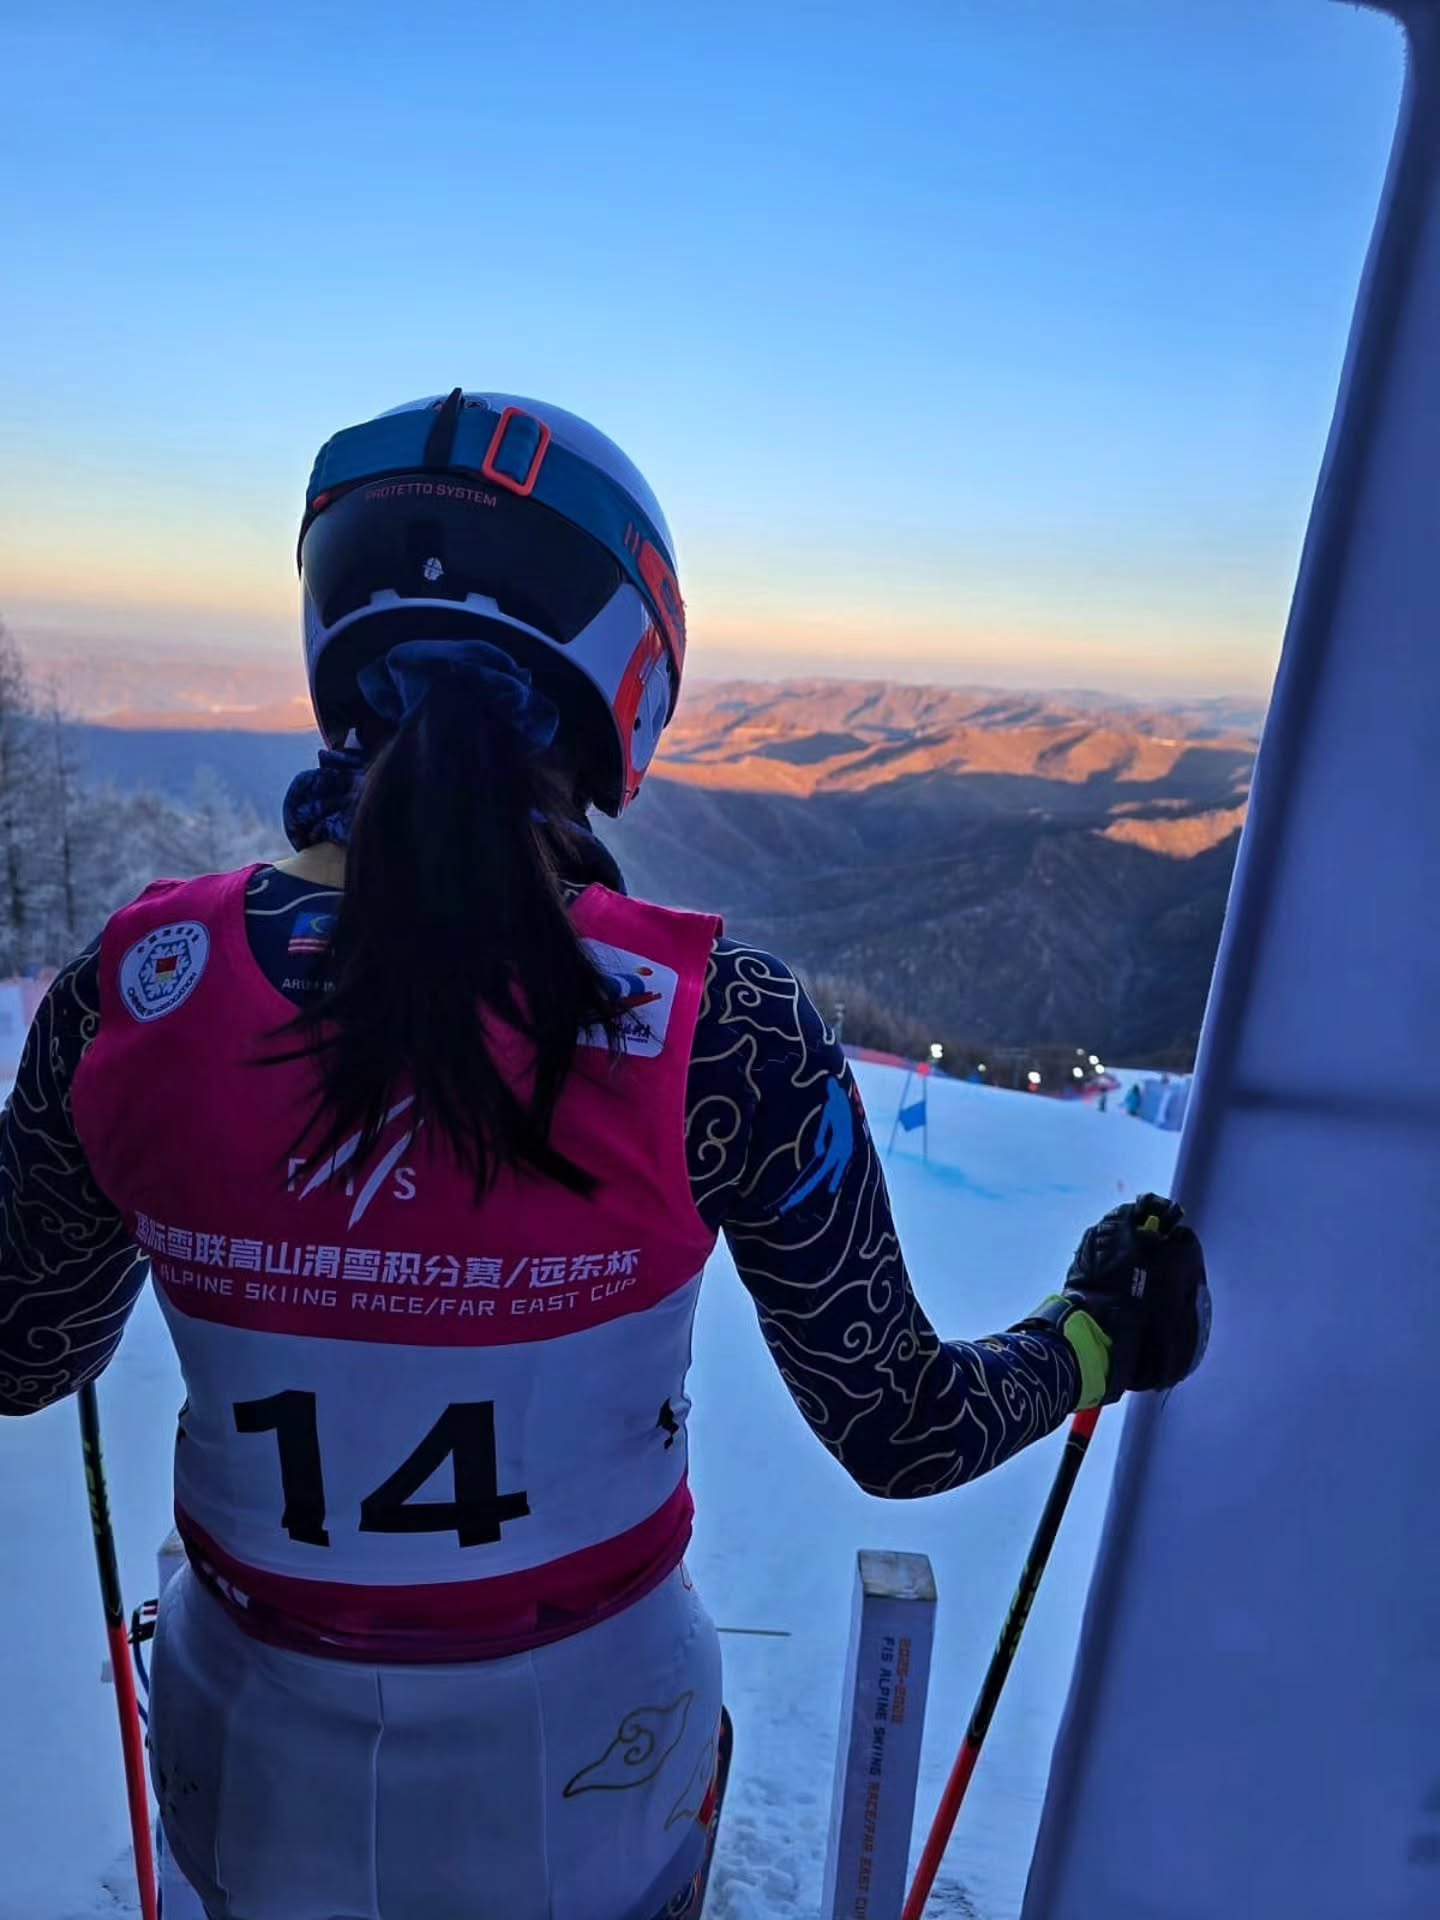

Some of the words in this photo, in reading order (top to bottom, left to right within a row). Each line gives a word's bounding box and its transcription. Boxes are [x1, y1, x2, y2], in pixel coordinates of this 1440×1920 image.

[436, 484, 497, 508] SYSTEM
[160, 1263, 234, 1296] ALPINE
[245, 1283, 338, 1307] SKIING
[352, 1292, 496, 1317] RACE/FAR
[511, 1291, 580, 1316] EAST
[591, 1278, 637, 1302] CUP
[232, 1388, 531, 1549] 14
[881, 1636, 895, 1663] FIS
[874, 1668, 893, 1721] ALPINE
[869, 1727, 886, 1777] SKIING
